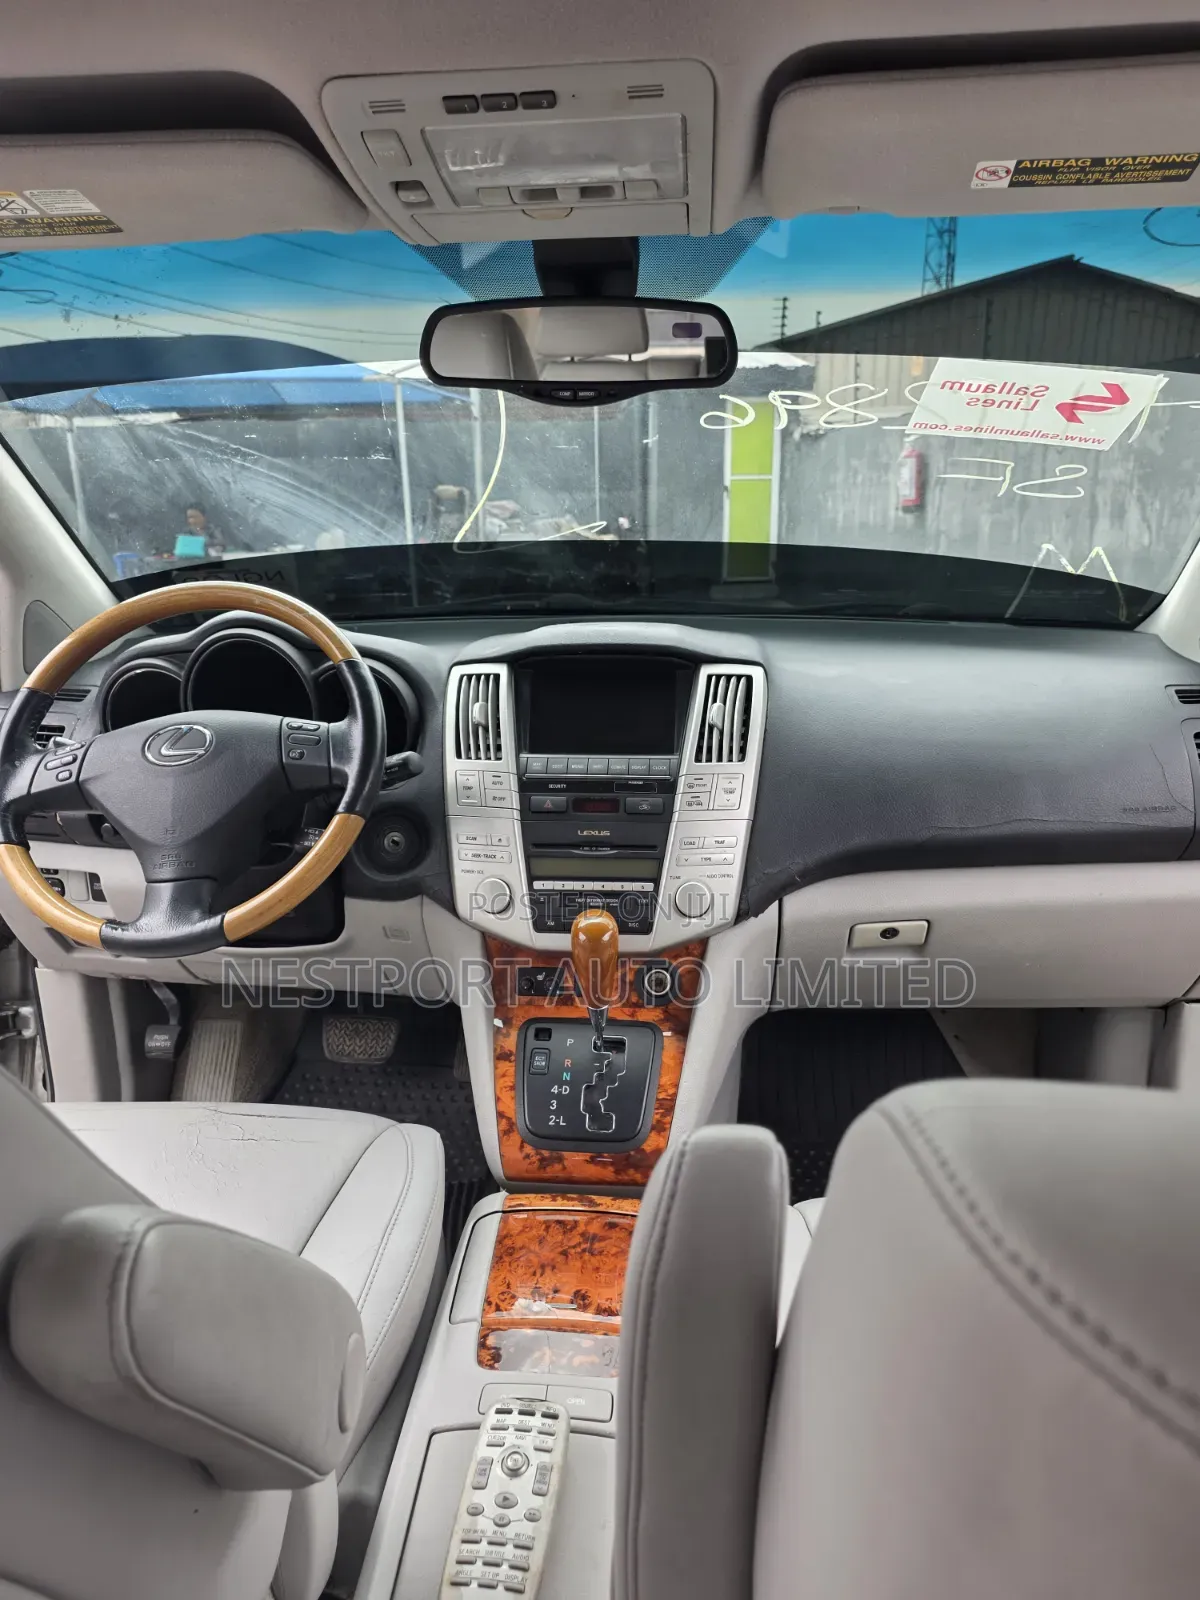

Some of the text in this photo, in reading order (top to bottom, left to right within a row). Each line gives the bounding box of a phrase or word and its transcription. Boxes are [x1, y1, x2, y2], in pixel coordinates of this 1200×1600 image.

[1018, 152, 1200, 169] AIRBAG WARNING
[1012, 168, 1192, 183] COUSSIN GONFLABLE AVERTISSEMENT
[25, 215, 108, 224] WARNING
[566, 1038, 575, 1047] P
[564, 1059, 572, 1067] R
[562, 1072, 571, 1081] N
[550, 1085, 570, 1094] 4-D
[549, 1100, 557, 1110] 3
[548, 1115, 567, 1126] 2-L
[513, 1532, 536, 1541] RETURN
[511, 1553, 530, 1561] AUDIO
[455, 1569, 474, 1577] ANGLE
[504, 1574, 529, 1584] DISPLAY
